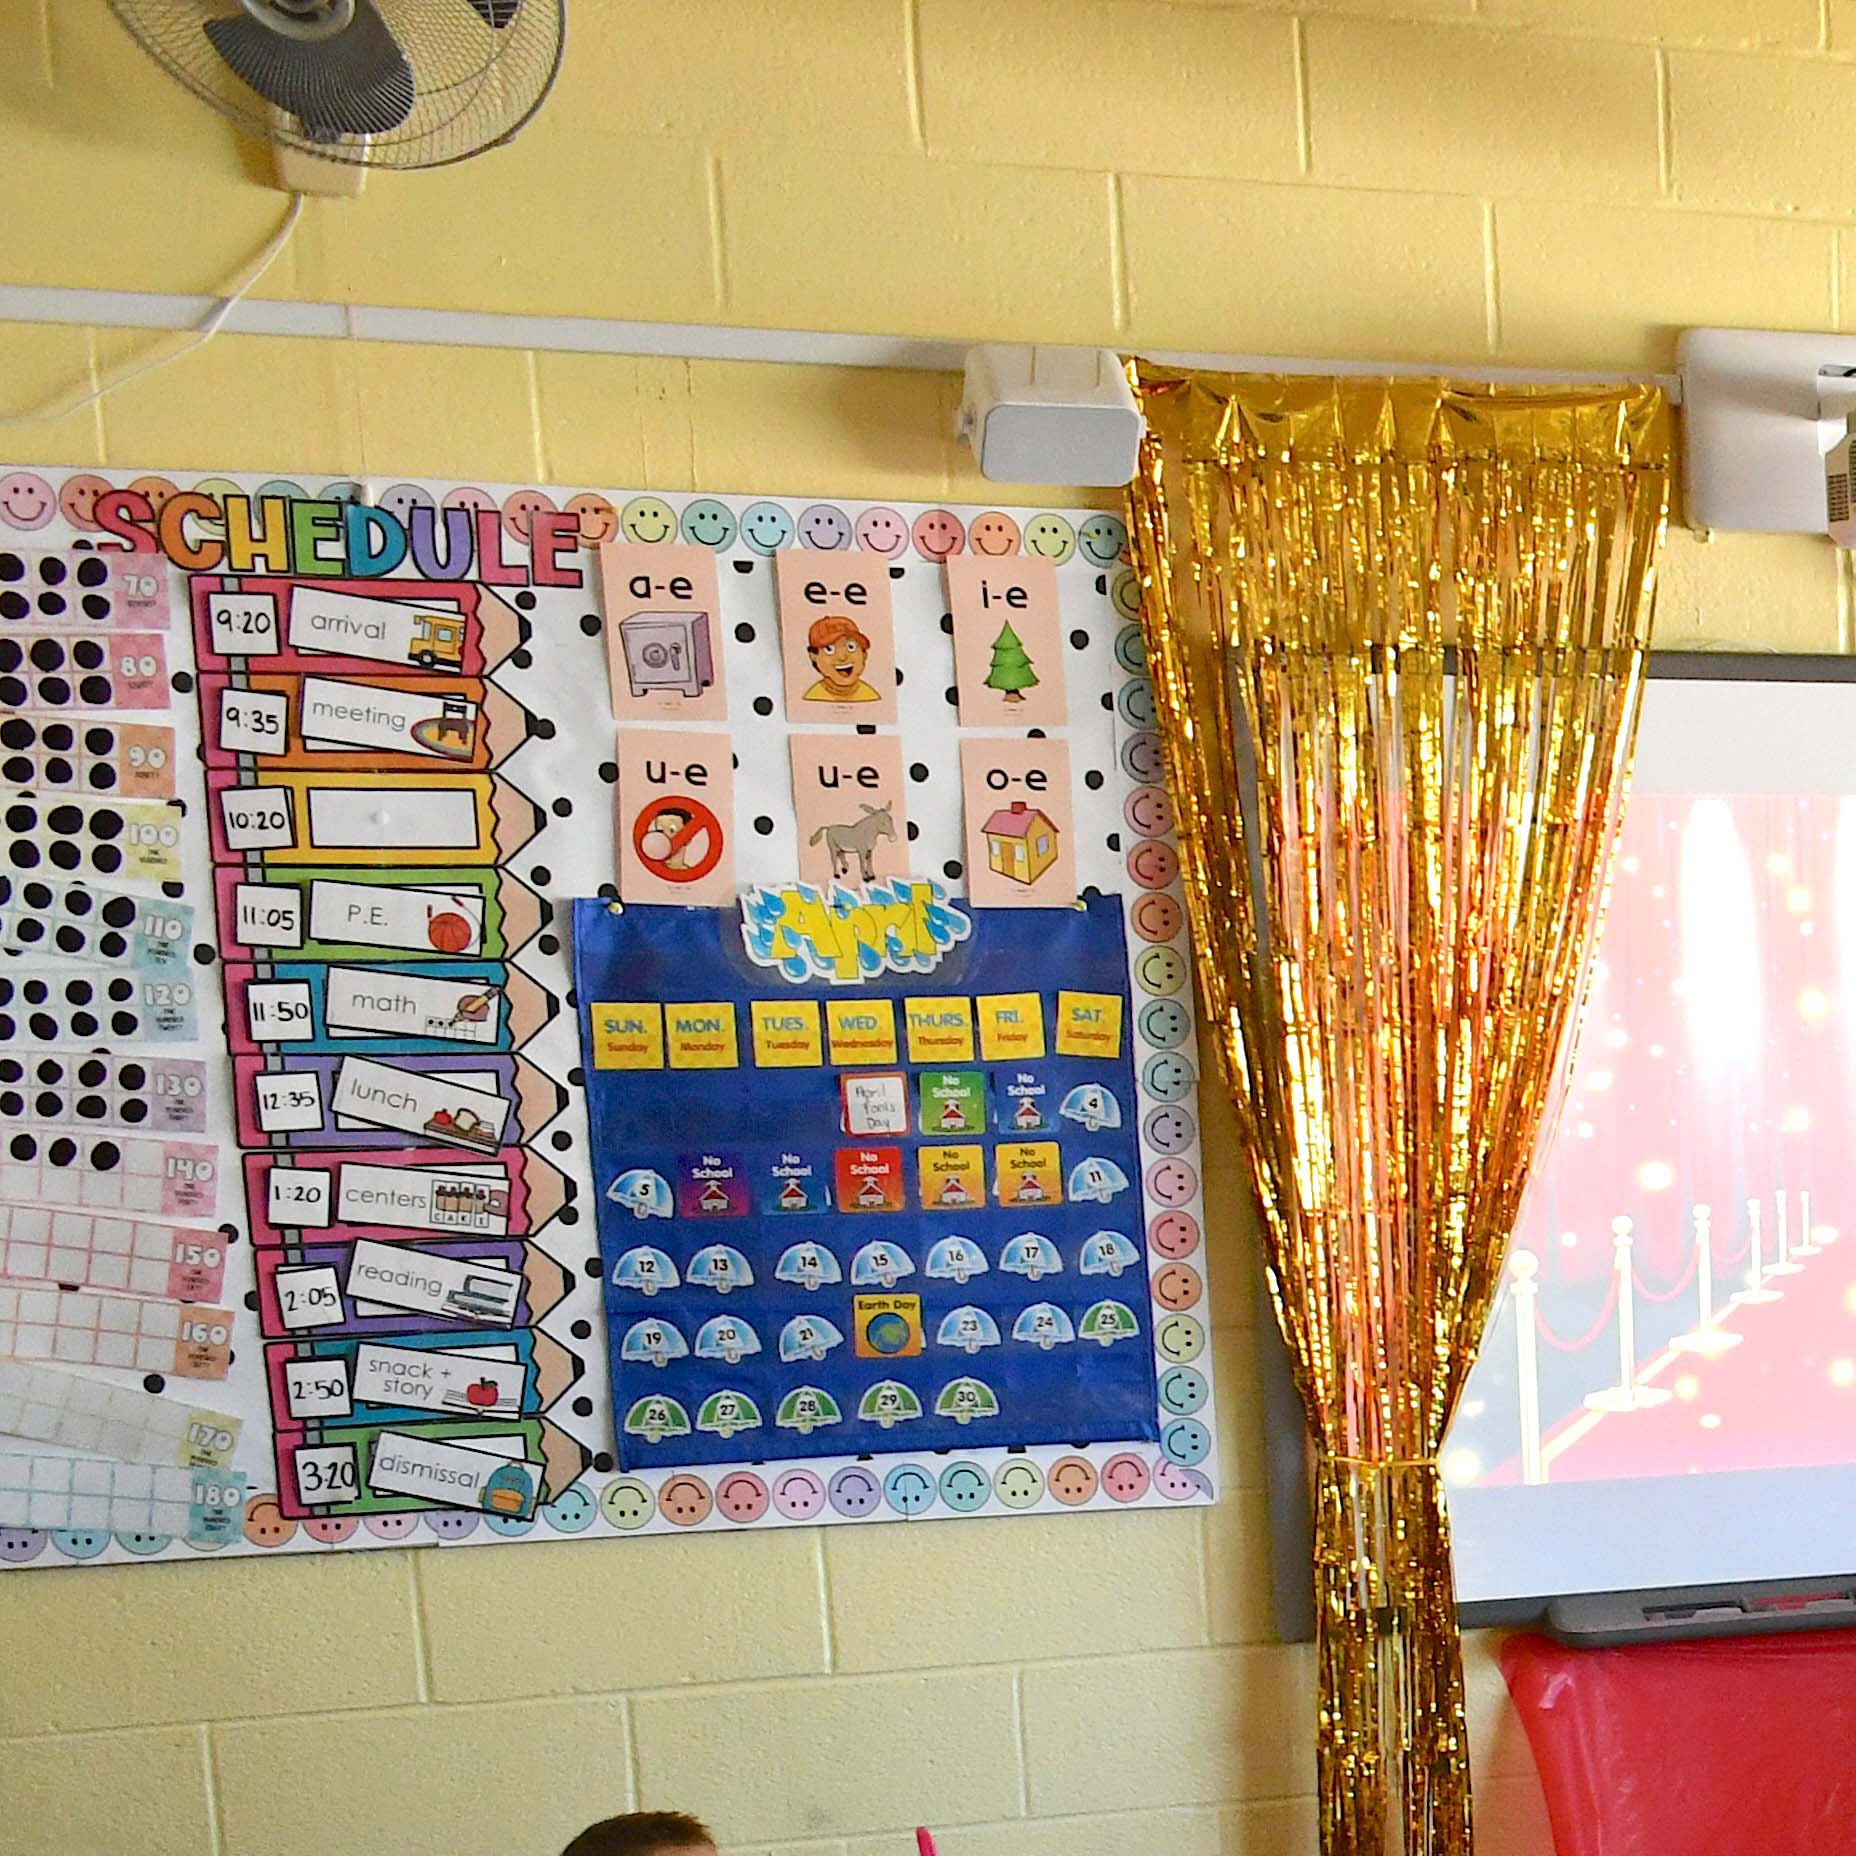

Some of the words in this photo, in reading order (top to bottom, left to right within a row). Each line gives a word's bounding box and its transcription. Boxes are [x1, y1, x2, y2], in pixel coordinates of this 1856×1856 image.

[92, 489, 584, 588] SCHEDULE
[122, 575, 159, 597] 70
[629, 575, 694, 601] a-e
[804, 580, 868, 605] e-e
[980, 580, 1029, 608] i-e
[216, 609, 271, 635] 9:20
[311, 614, 386, 641] arrival
[120, 655, 157, 678] 80
[225, 707, 279, 734] 9:35
[312, 698, 406, 732] meeting
[646, 760, 709, 786] u-e
[818, 762, 880, 789] u-e
[986, 767, 1048, 791] o-e
[229, 811, 285, 830] 10:20
[129, 824, 178, 848] 100
[243, 905, 295, 931] 11:05
[347, 904, 389, 926] P.E.
[144, 916, 183, 942] 110
[771, 883, 937, 979] April
[143, 983, 192, 1006] 120
[352, 991, 417, 1015] math
[252, 1002, 309, 1021] 11:50
[604, 1019, 648, 1034] SUN.
[607, 1042, 649, 1054] Sunday
[765, 1039, 810, 1051] Tuesday
[832, 1038, 893, 1050] Wednesday
[917, 1036, 964, 1047] Thursday
[154, 1073, 202, 1097] 130
[942, 1075, 960, 1087] No
[1007, 1084, 1046, 1096] School
[1016, 1073, 1034, 1084] No
[263, 1091, 315, 1111] 12:35
[351, 1078, 417, 1112] lunch
[932, 1086, 971, 1099] School
[703, 1155, 721, 1167] No
[781, 1153, 800, 1165] No
[860, 1152, 877, 1162] No
[943, 1150, 959, 1160] No
[1009, 1158, 1046, 1169] School
[1019, 1147, 1036, 1157] No
[166, 1158, 214, 1181] 140
[692, 1167, 733, 1179] School
[772, 1165, 812, 1177] School
[850, 1163, 889, 1175] School
[933, 1161, 970, 1172] School
[274, 1185, 321, 1203] 1:20
[345, 1186, 427, 1208] centers
[175, 1243, 221, 1269] 150
[639, 1261, 654, 1273] 12
[712, 1259, 728, 1271] 13
[801, 1256, 818, 1268] 14
[872, 1254, 888, 1266] 15
[949, 1250, 964, 1262] 16
[1025, 1246, 1039, 1258] 17
[1099, 1244, 1115, 1256] 18
[357, 1263, 443, 1297] reading
[285, 1286, 337, 1311] 2:05
[858, 1300, 890, 1311] Earth
[894, 1300, 917, 1313] Day
[181, 1320, 228, 1345] 160
[646, 1332, 662, 1344] 19
[718, 1329, 736, 1341] 20
[800, 1328, 814, 1341] 21
[962, 1320, 978, 1332] 23
[1037, 1317, 1053, 1328] 24
[1100, 1313, 1116, 1325] 25
[369, 1358, 433, 1379] snack
[293, 1379, 344, 1400] 2:50
[383, 1377, 434, 1400] story
[649, 1409, 666, 1421] 26
[720, 1404, 736, 1416] 27
[800, 1400, 816, 1412] 28
[880, 1394, 897, 1406] 29
[958, 1391, 975, 1403] 30
[379, 1454, 481, 1490] dismissal
